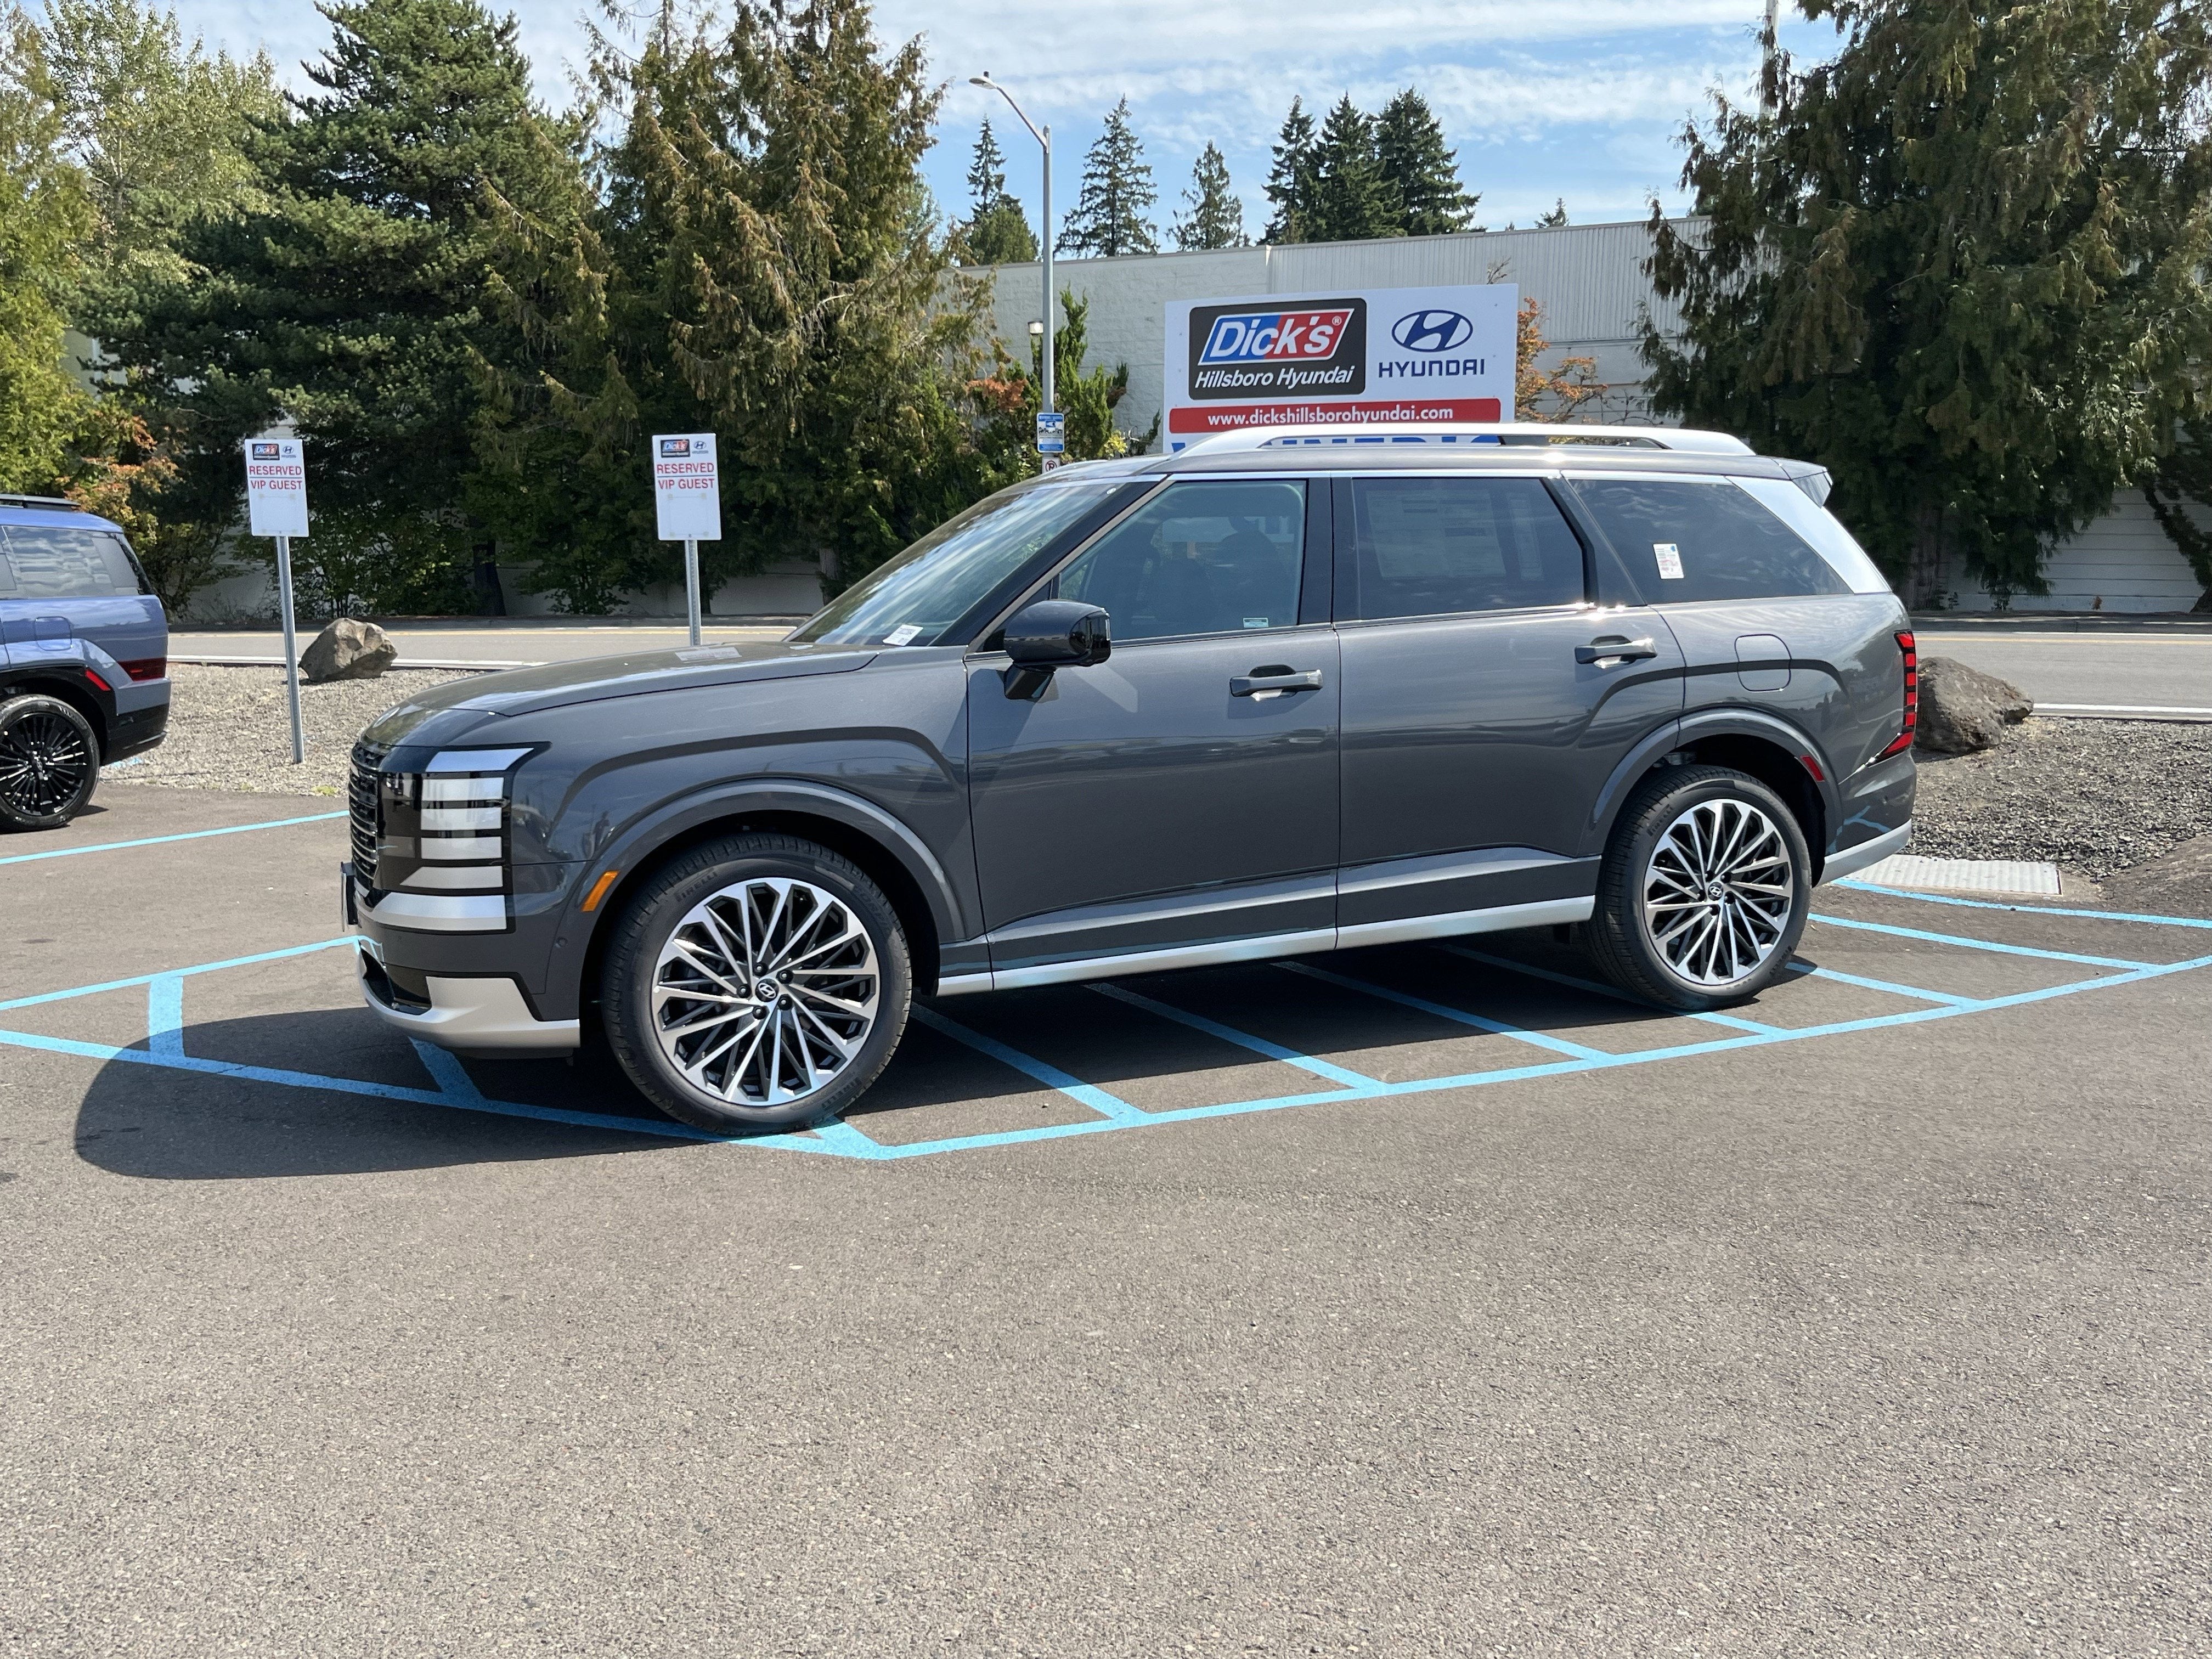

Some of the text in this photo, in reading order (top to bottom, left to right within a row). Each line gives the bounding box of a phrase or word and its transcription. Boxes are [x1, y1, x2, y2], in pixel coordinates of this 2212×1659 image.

[1379, 359, 1485, 377] HYUNDAI
[1195, 365, 1356, 389] Hillsboro Hyundai
[1207, 405, 1453, 426] www.dickshillsborohyundai.com
[249, 466, 302, 476] RESERVED
[657, 462, 714, 474] RESERVED
[251, 480, 302, 490] VIP GUEST
[658, 478, 715, 489] VIP GUEST
